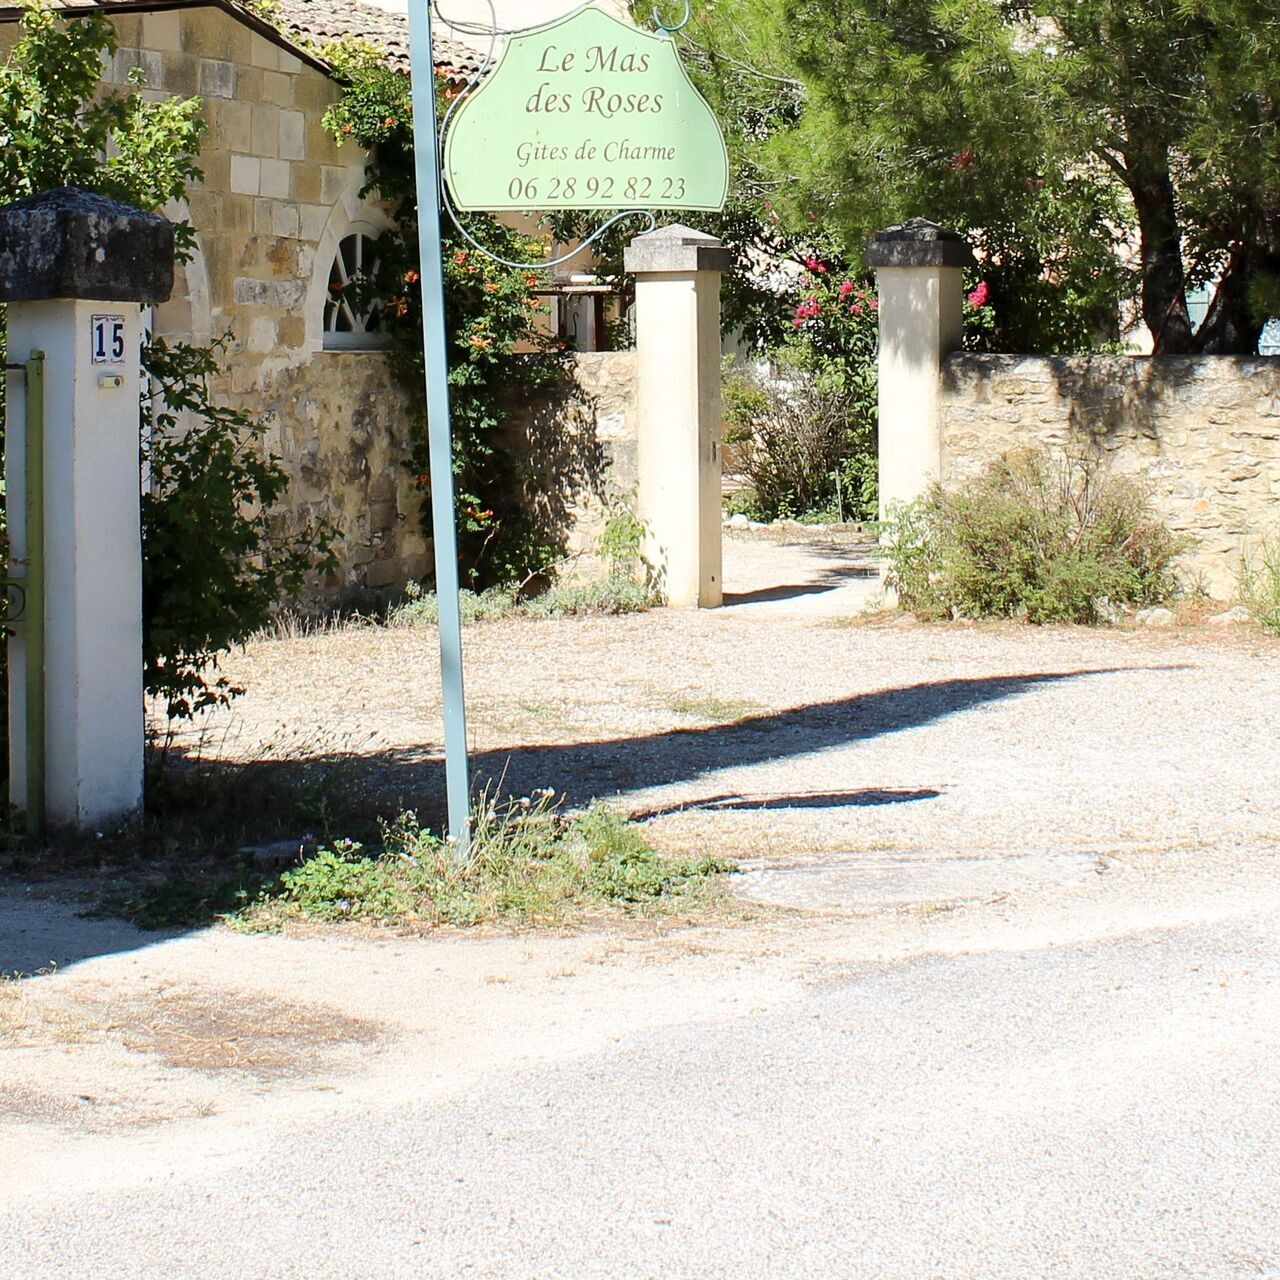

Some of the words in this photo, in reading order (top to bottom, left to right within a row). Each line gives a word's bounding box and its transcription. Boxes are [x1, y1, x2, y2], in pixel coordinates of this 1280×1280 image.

[536, 45, 575, 72] Le
[584, 45, 651, 73] Mas
[525, 82, 572, 113] des
[582, 86, 663, 119] Roses
[574, 139, 597, 160] de
[603, 139, 676, 162] Charme
[508, 177, 540, 200] 06
[547, 177, 577, 199] 28
[584, 177, 615, 199] 92
[623, 177, 652, 200] 82
[660, 177, 686, 200] 23
[95, 323, 124, 357] 15
